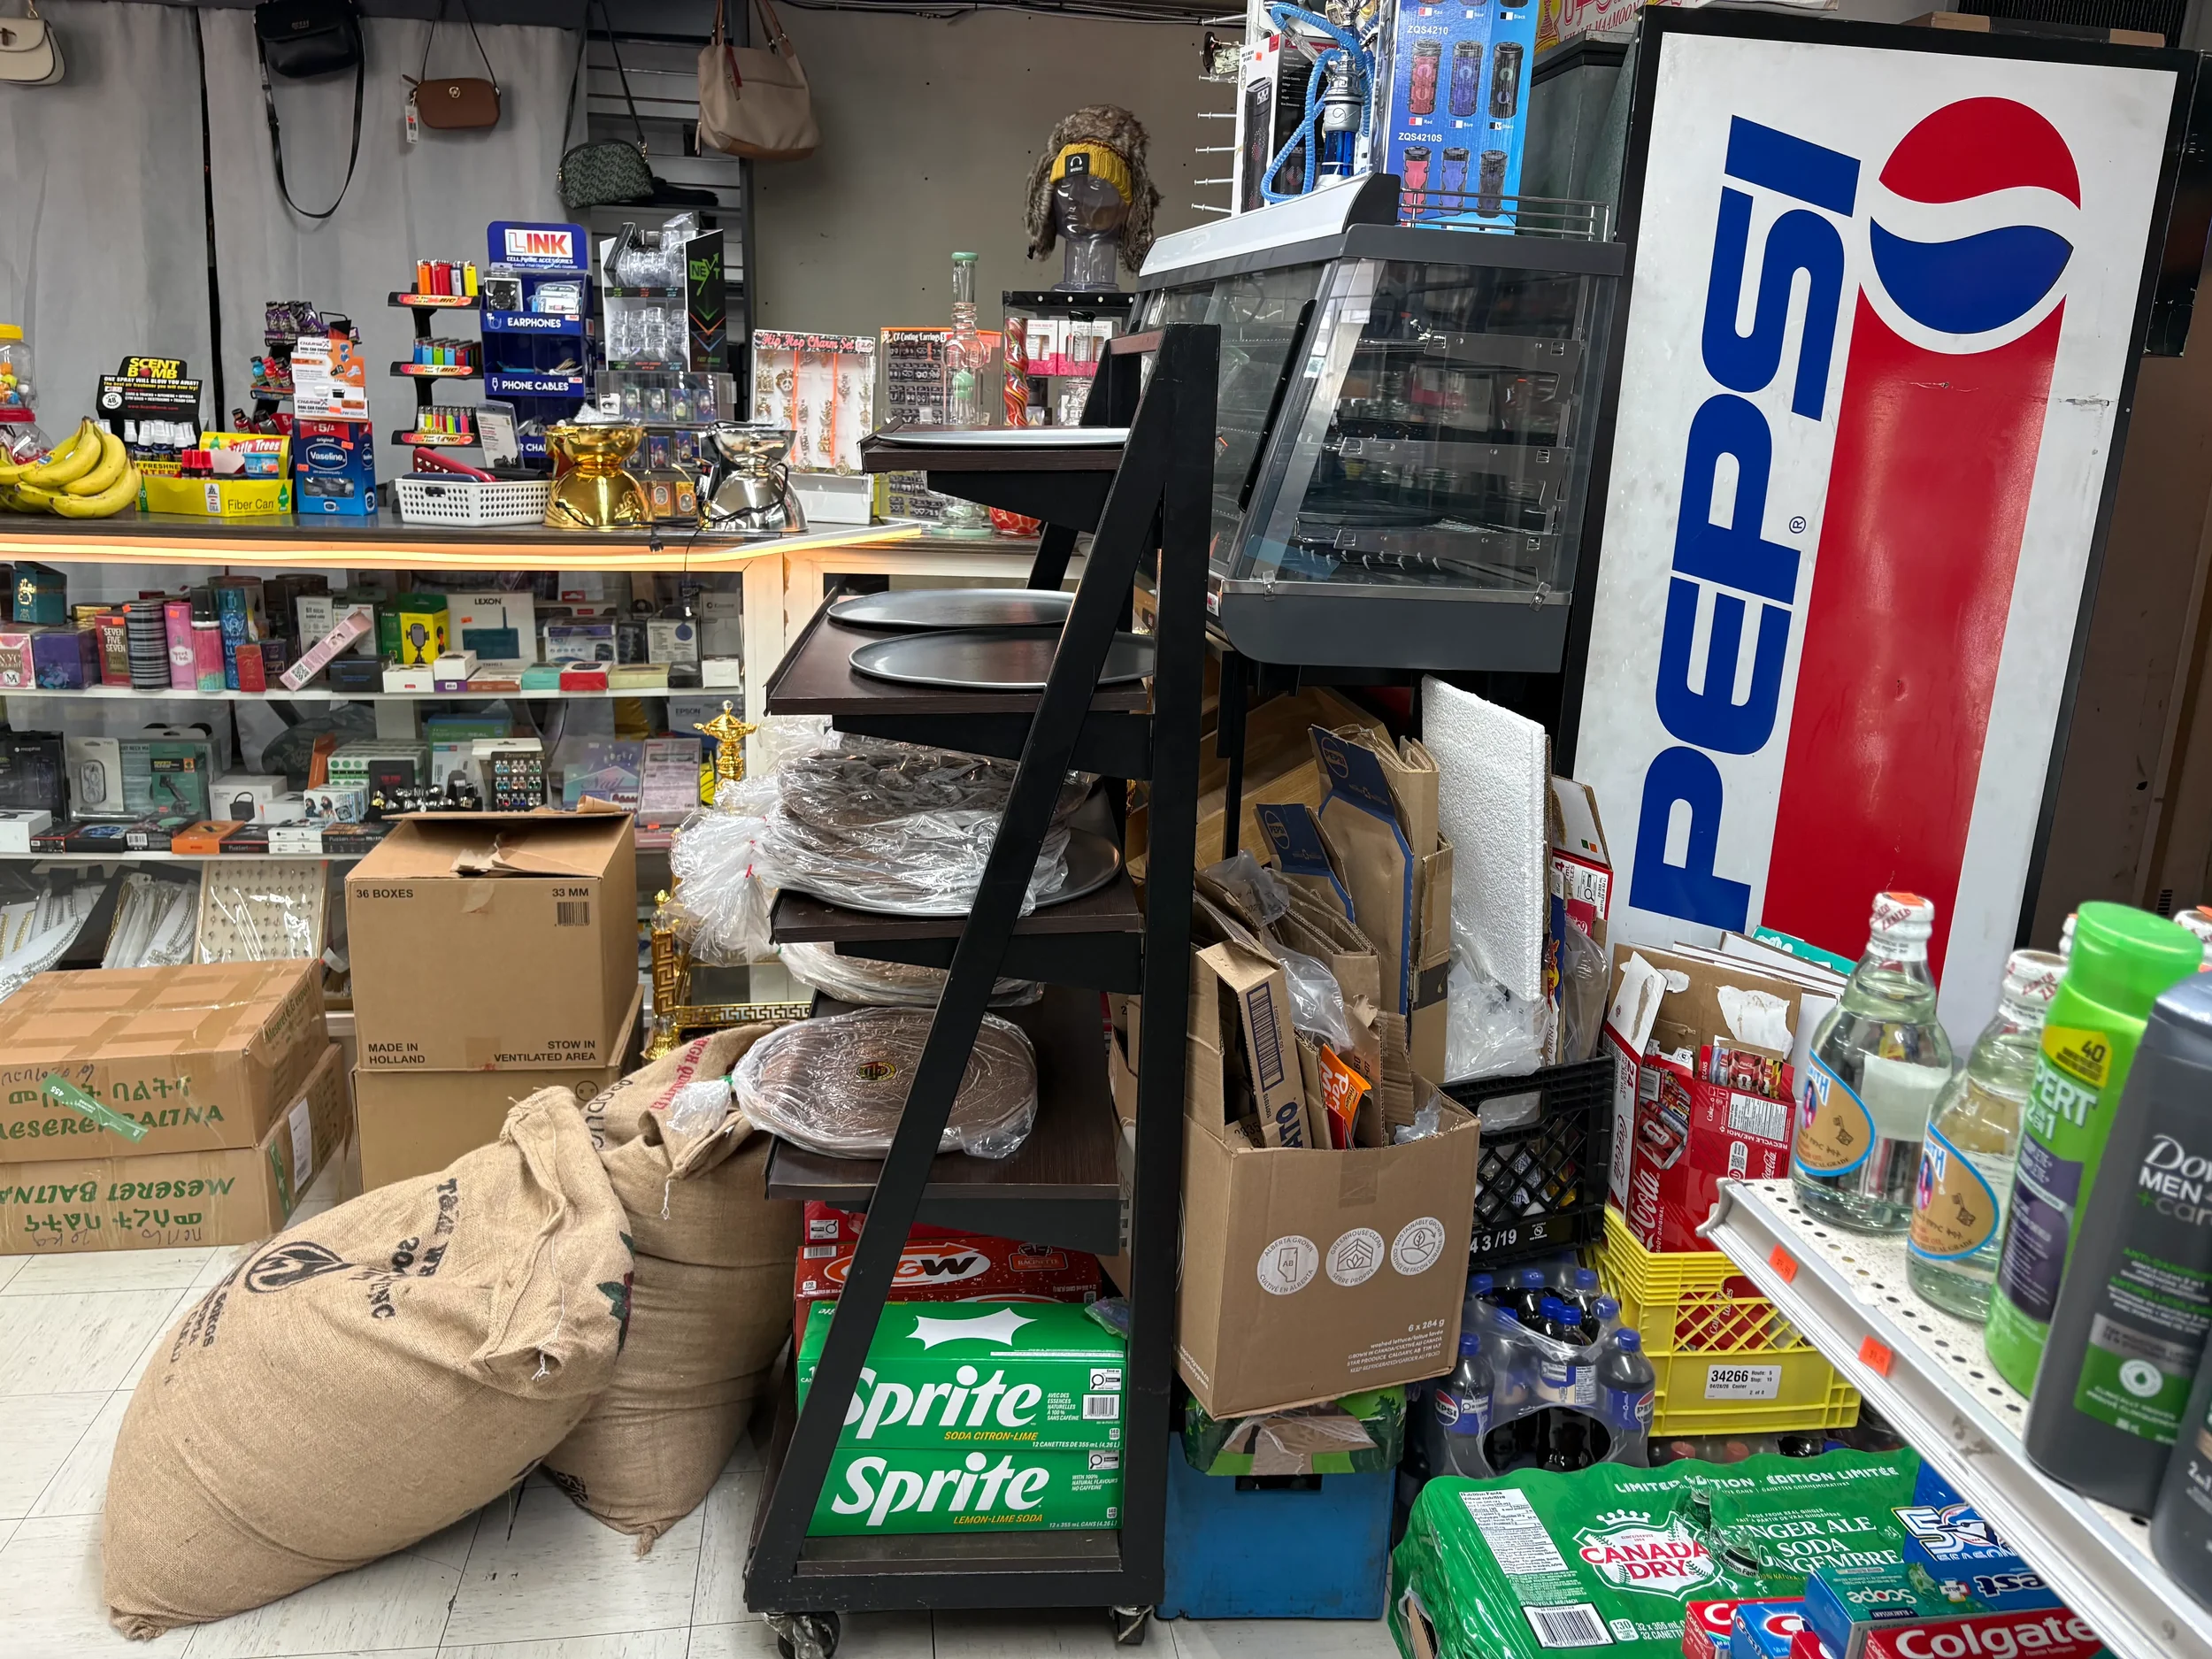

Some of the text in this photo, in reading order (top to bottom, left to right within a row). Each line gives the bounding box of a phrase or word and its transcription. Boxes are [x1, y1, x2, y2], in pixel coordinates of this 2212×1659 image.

[1408, 25, 1448, 35] ZQS4210
[1398, 132, 1442, 142] ZQS4210S
[509, 232, 567, 255] LINK
[507, 318, 561, 328] EARPHONES
[760, 332, 781, 349] Hip
[783, 334, 804, 349] Hop
[807, 334, 838, 349] Charm
[840, 337, 855, 349] Set
[129, 357, 180, 370] SCENT
[502, 380, 569, 391] PHONE CABLES
[255, 439, 280, 451] Trees
[310, 451, 344, 461] Vaseline
[227, 498, 273, 511] Fiber Can
[1628, 115, 1862, 931] PEPSI
[104, 627, 124, 636] SEVEN
[107, 636, 121, 645] FIVE
[105, 644, 126, 653] SEVEN
[356, 888, 413, 899] 36 BOXES
[551, 887, 589, 897] 33 MM
[368, 1042, 419, 1053] MADE IN
[547, 1040, 595, 1050] STOW IN
[2081, 1040, 2106, 1062] 40
[369, 1054, 426, 1064] HOLLAND
[494, 1052, 596, 1063] VENTILATED AREA
[50, 1086, 65, 1098] 455
[1726, 1128, 1761, 1142] ME/MOI
[1760, 1137, 1788, 1150] RECYCLE
[2138, 1167, 2203, 1203] MEN
[1657, 1205, 1666, 1233] ORIGINAL
[1394, 1219, 1444, 1247] SUSTAINABLY GROWN
[1263, 1237, 1315, 1257] ALBERTA GROWN
[1330, 1228, 1383, 1255] GREENHOUSE CLEAN
[1259, 1274, 1279, 1293] CULTIVÉ
[1289, 1269, 1314, 1292] ALBERTA
[1332, 1269, 1374, 1284] SERRE PROPRE
[1408, 1318, 1445, 1333] 6 284 g
[1348, 1351, 1368, 1360] GROWN
[1423, 1336, 1442, 1345] CANADA
[1371, 1340, 1393, 1349] washed
[1361, 1349, 1413, 1364] PRODUCE CALGARY,
[1710, 1370, 1749, 1382] 34266
[842, 1363, 1042, 1440] Sprite
[943, 1431, 1038, 1441] SODA CITRON-LIME
[1767, 1472, 1837, 1487] ÉDITION
[1839, 1464, 1901, 1480] LIMITÉE
[830, 1451, 1051, 1526] Sprite
[953, 1514, 1043, 1525] LEMON-LIME SODA
[1803, 1510, 1842, 1519] GINGEMBRE
[1828, 1516, 1878, 1535] ALE
[1579, 1539, 1713, 1566] CANADA
[1777, 1537, 1851, 1558] SODA
[1624, 1559, 1689, 1580] DRY
[1846, 1586, 1919, 1605] Scope
[1611, 1620, 1631, 1631] 130
[1636, 1623, 1647, 1632] 32
[1653, 1622, 1667, 1631] 355
[1668, 1621, 1680, 1630] mL
[1684, 1610, 1711, 1643] Colgate
[1895, 1616, 2105, 1659] Colgate
